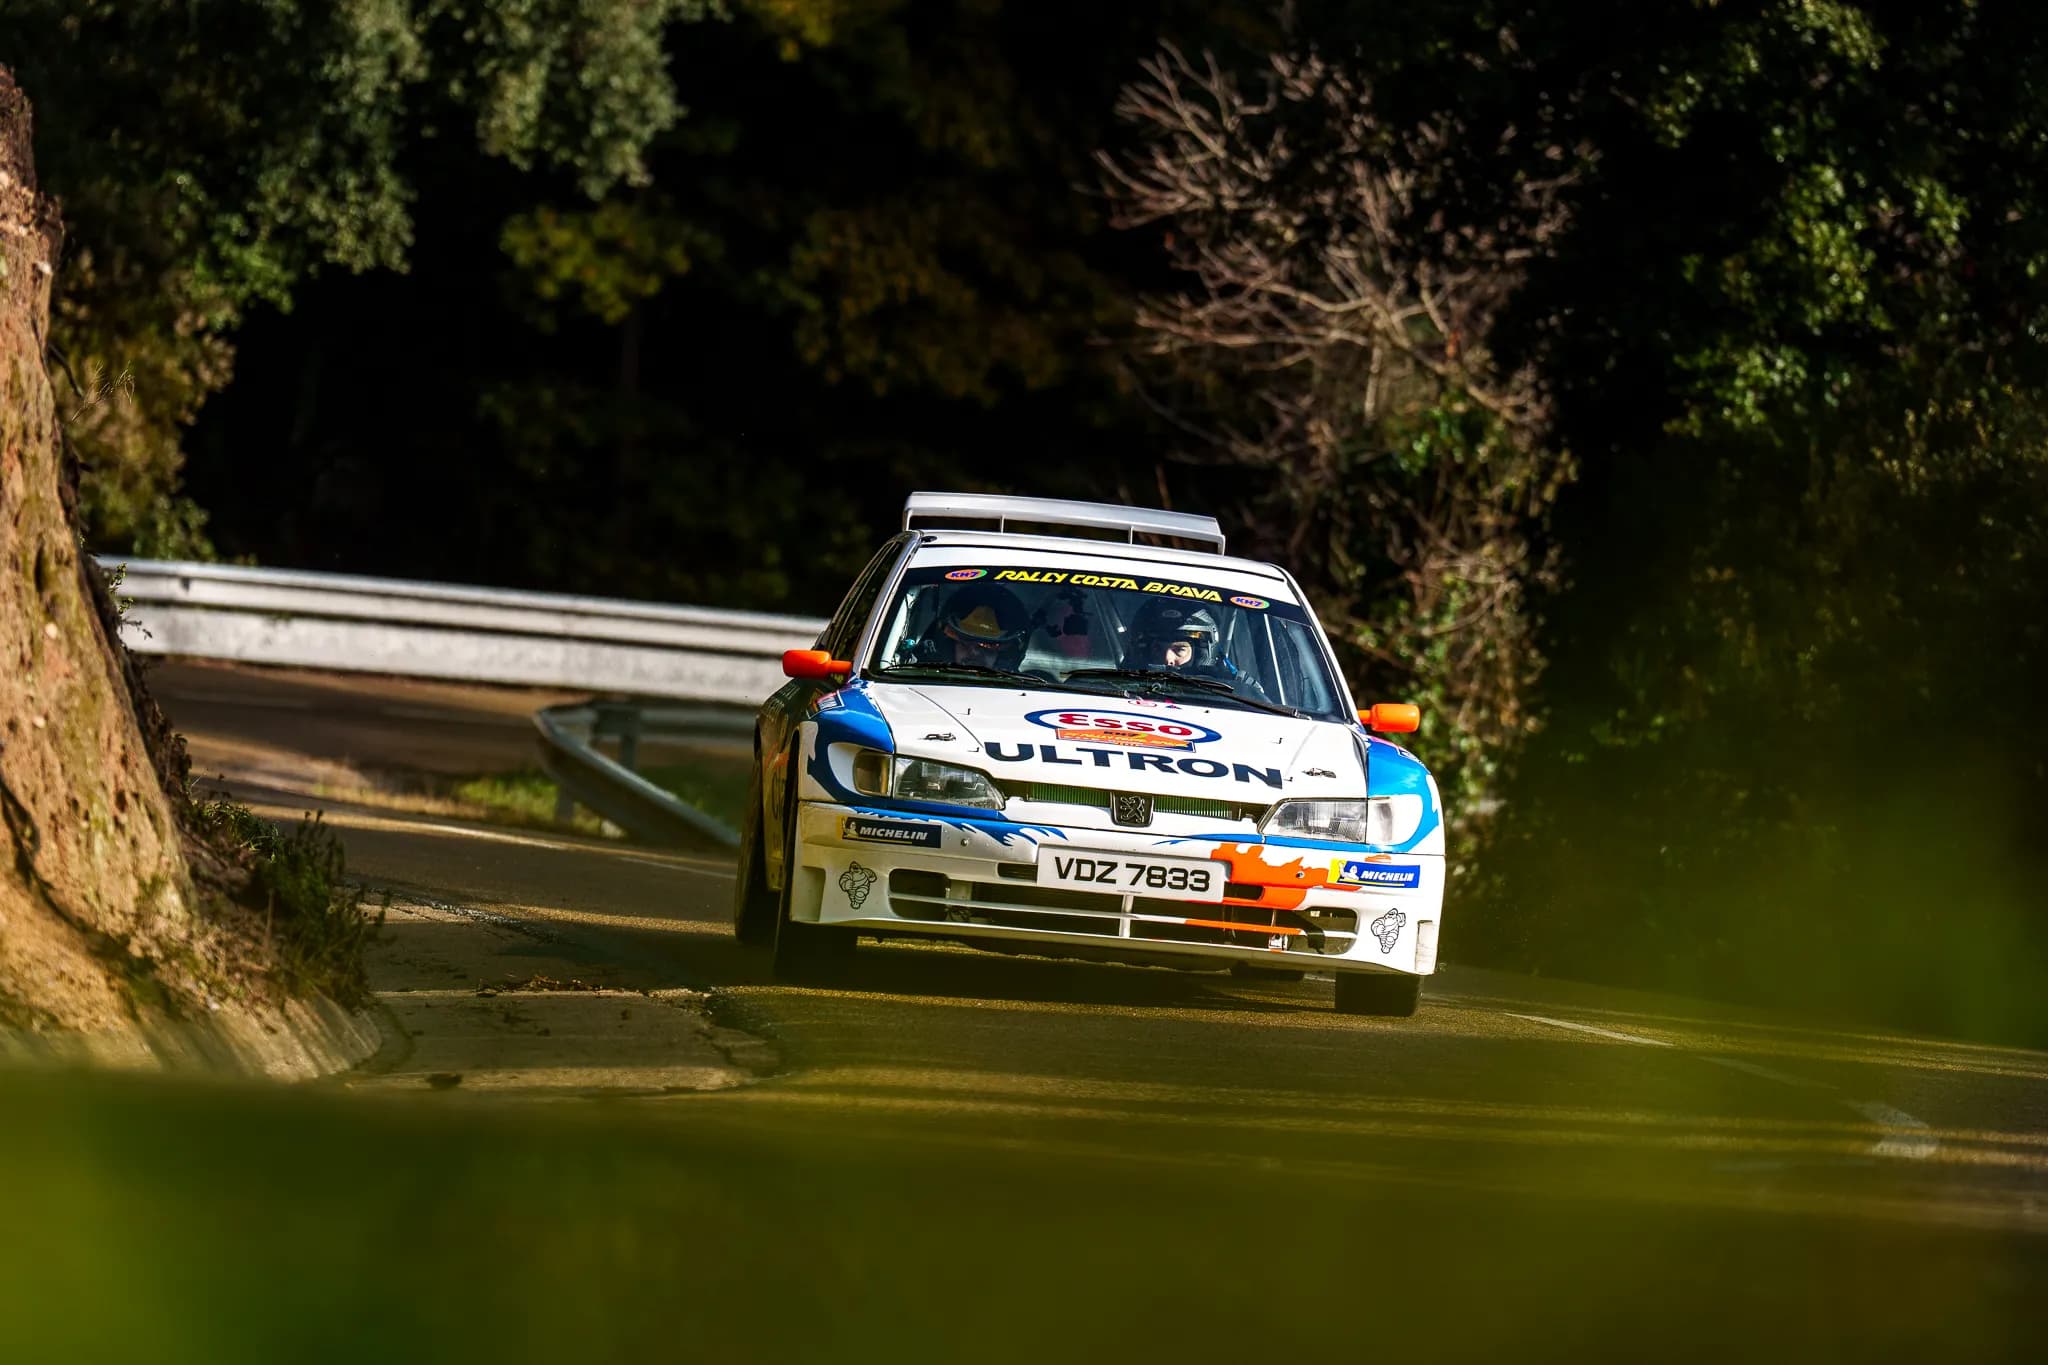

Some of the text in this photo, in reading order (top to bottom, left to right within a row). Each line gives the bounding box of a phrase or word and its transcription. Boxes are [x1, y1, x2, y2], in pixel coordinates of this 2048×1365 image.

[994, 569, 1223, 602] RALLY COSTA BRAVA
[984, 741, 1283, 789] ULTRON
[859, 826, 928, 840] MICHELIN
[1054, 857, 1210, 892] VDZ 7833
[1361, 870, 1415, 882] MICHELIN
